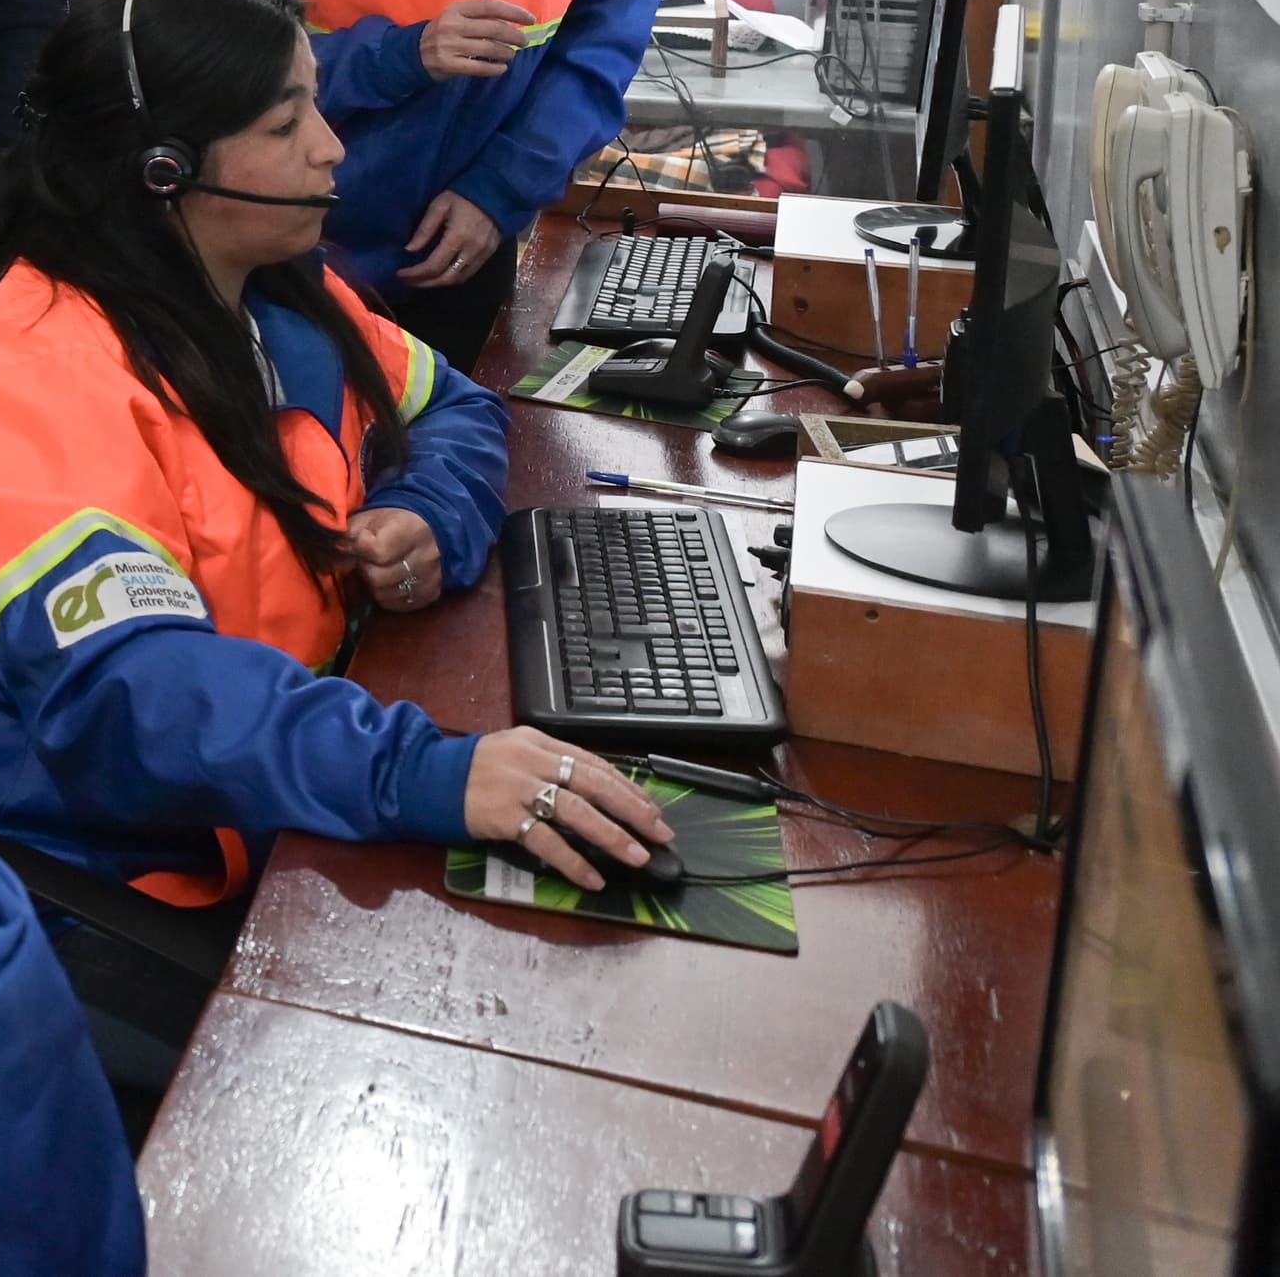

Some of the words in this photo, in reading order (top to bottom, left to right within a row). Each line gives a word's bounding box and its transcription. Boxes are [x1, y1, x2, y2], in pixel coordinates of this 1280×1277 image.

[121, 574, 166, 586] SALUD
[126, 586, 181, 599] Gobierno
[130, 596, 164, 608] Entre
